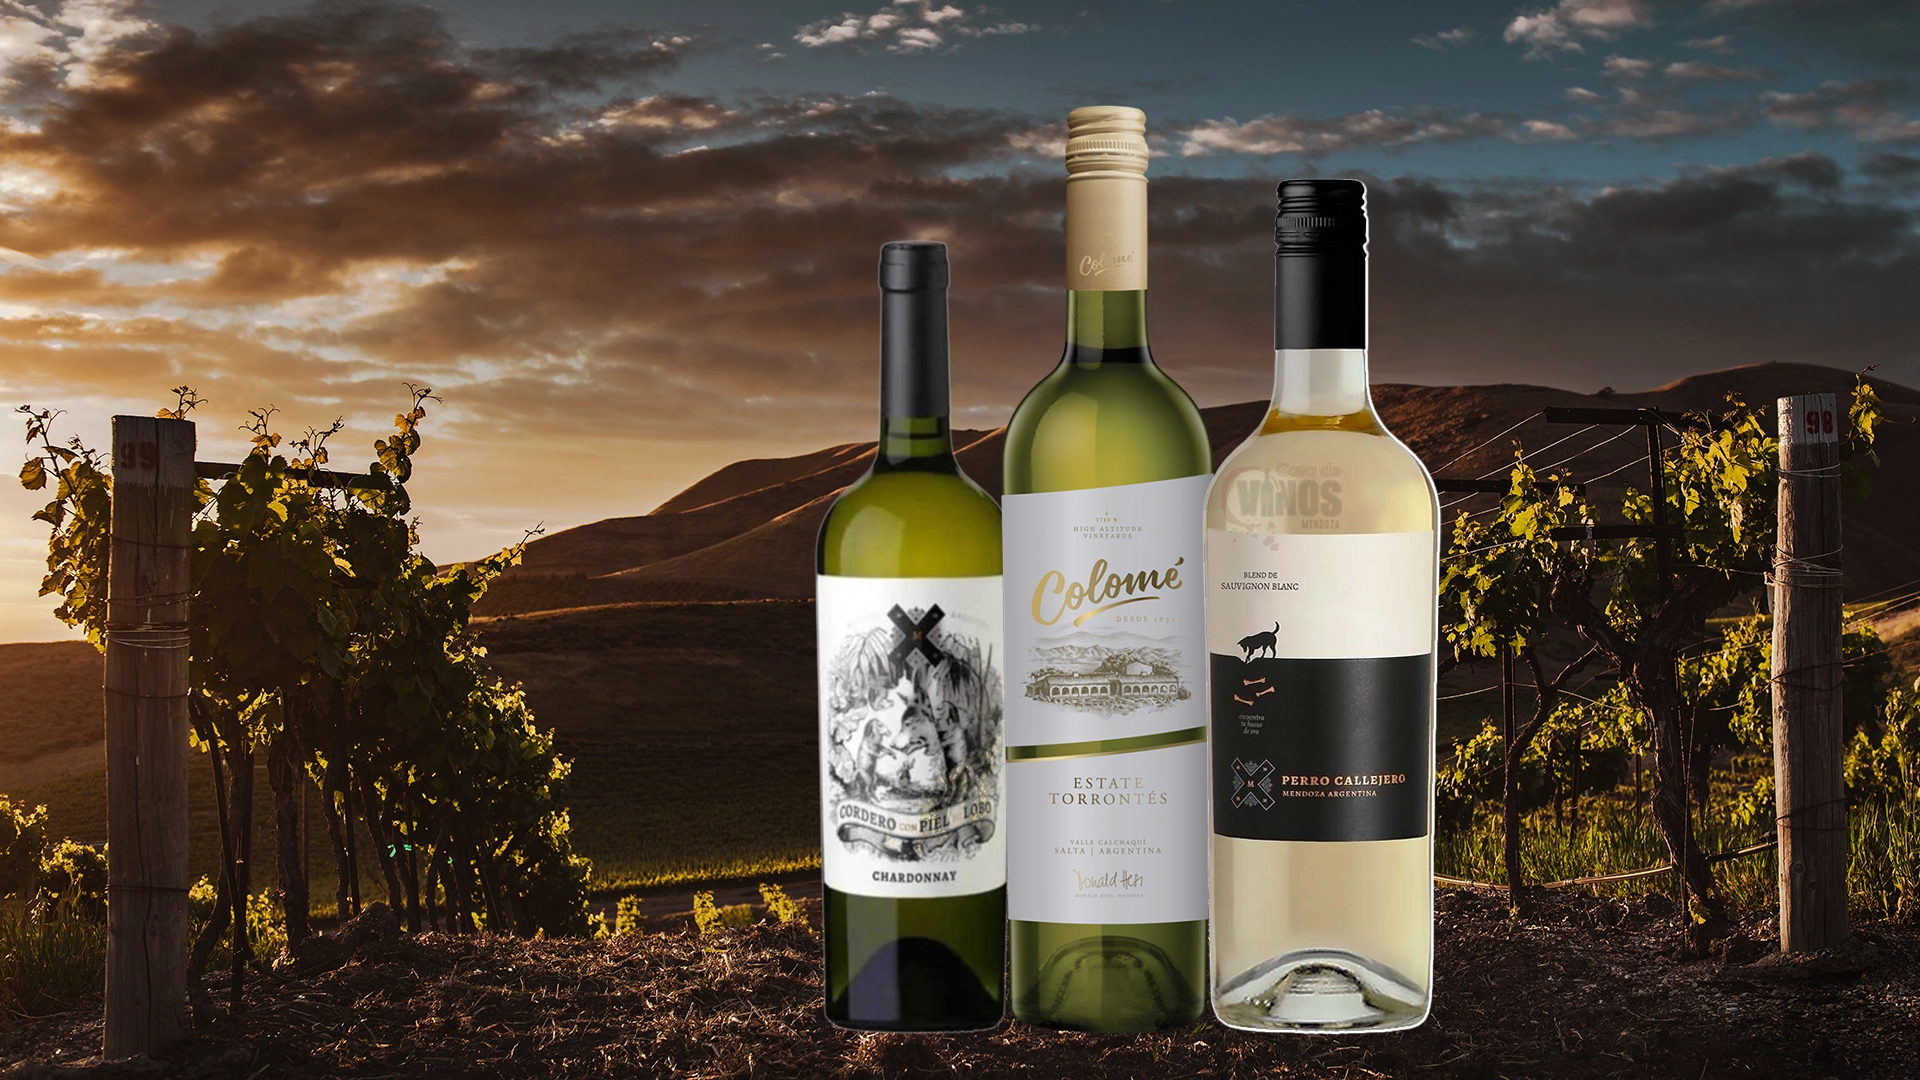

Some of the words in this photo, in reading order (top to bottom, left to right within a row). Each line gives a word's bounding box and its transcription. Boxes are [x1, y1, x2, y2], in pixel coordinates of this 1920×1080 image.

[1806, 410, 1833, 434] 98
[120, 442, 156, 470] 99
[1243, 571, 1267, 579] BLEND
[1268, 571, 1278, 579] DE
[1031, 556, 1185, 626] Colomé
[1221, 581, 1270, 591] SAUVIGNON
[1272, 582, 1299, 591] BLANC
[1116, 615, 1149, 623] DESDE
[1154, 616, 1176, 624] 1831
[1073, 777, 1144, 789] ESTATE
[1281, 775, 1330, 786] PERRO
[1333, 773, 1406, 786] CALLEJERO
[1049, 790, 1168, 805] TORRONTÉS
[839, 804, 897, 831] CORDERO
[899, 821, 917, 832] CON
[919, 815, 950, 833] PIEL
[1098, 838, 1147, 847] CALCHAQUÍ
[1054, 847, 1087, 855] SALTA
[1098, 847, 1162, 855] ARGENTINA
[872, 870, 957, 883] CHARDONNAY
